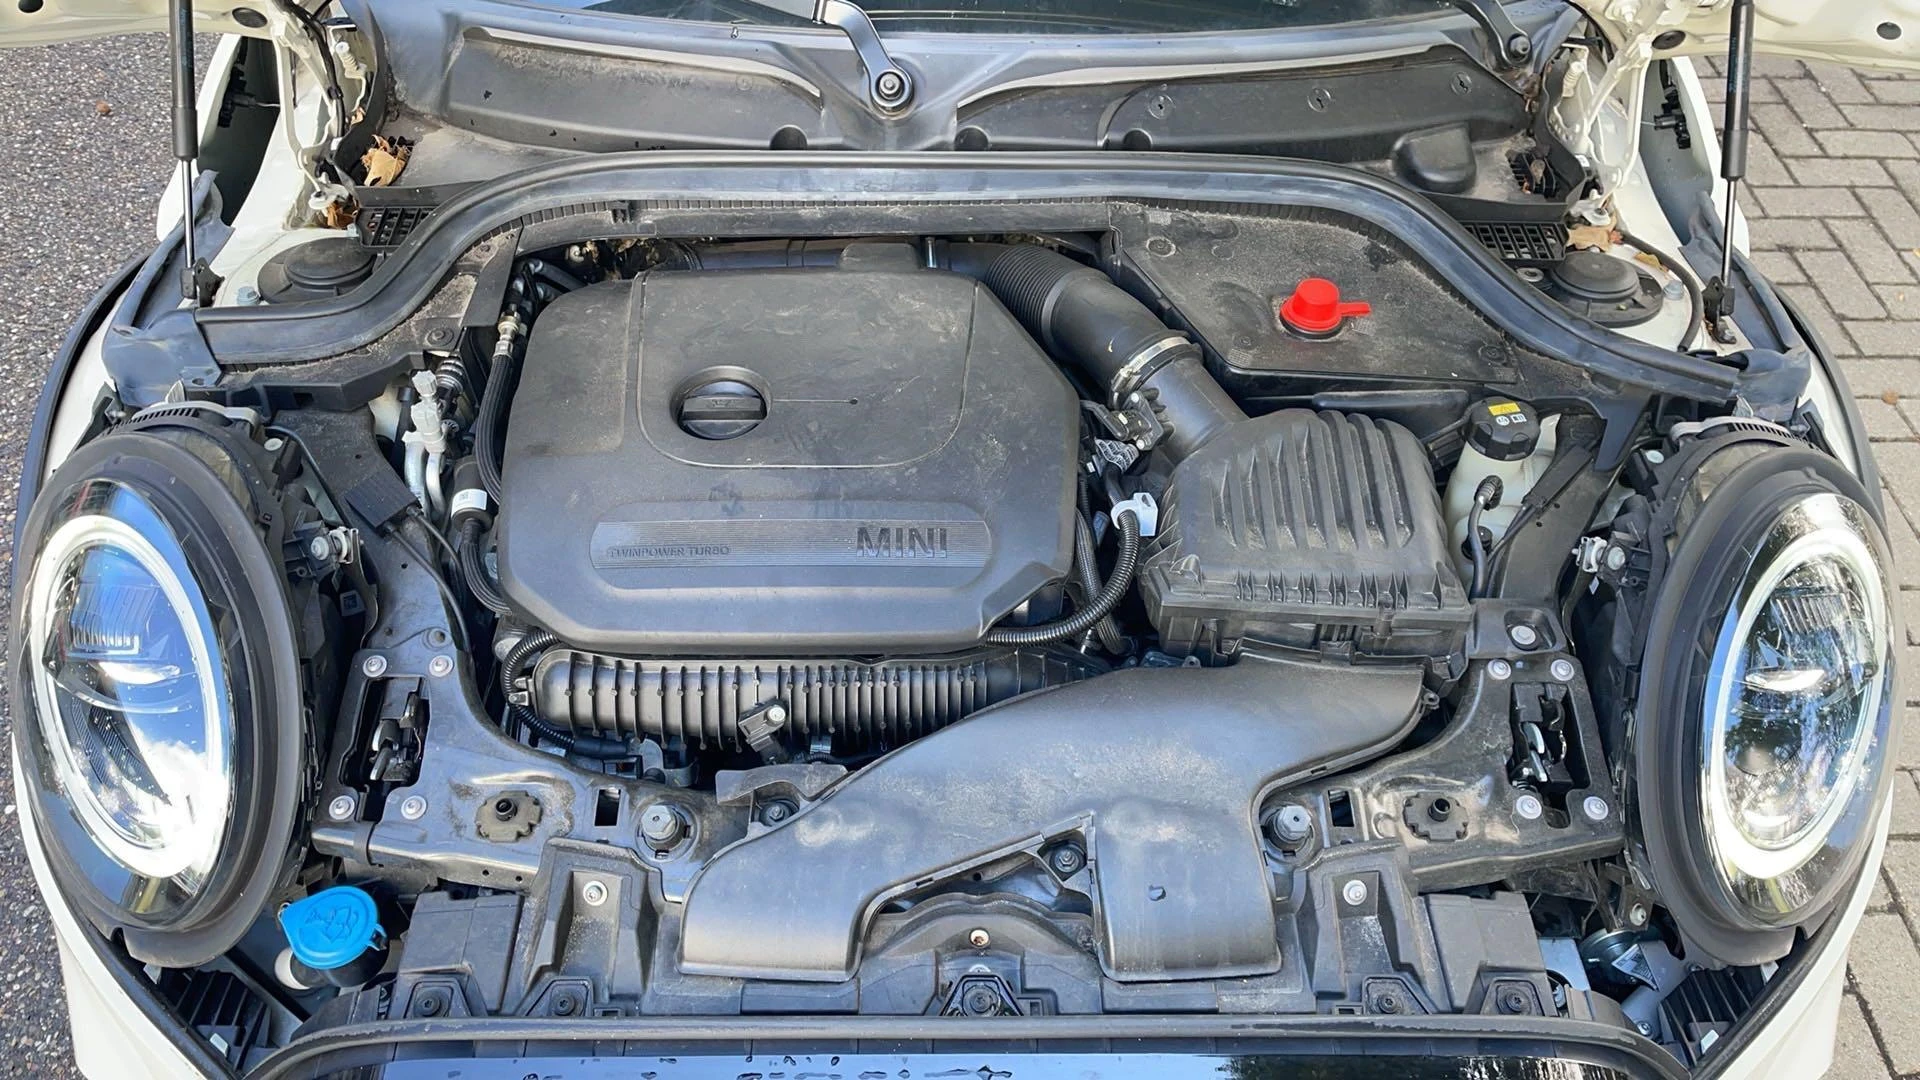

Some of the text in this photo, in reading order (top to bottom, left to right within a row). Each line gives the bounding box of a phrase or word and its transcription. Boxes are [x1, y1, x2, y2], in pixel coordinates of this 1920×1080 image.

[609, 545, 730, 558] TWINPOWER TURBO
[856, 526, 948, 558] MINI
